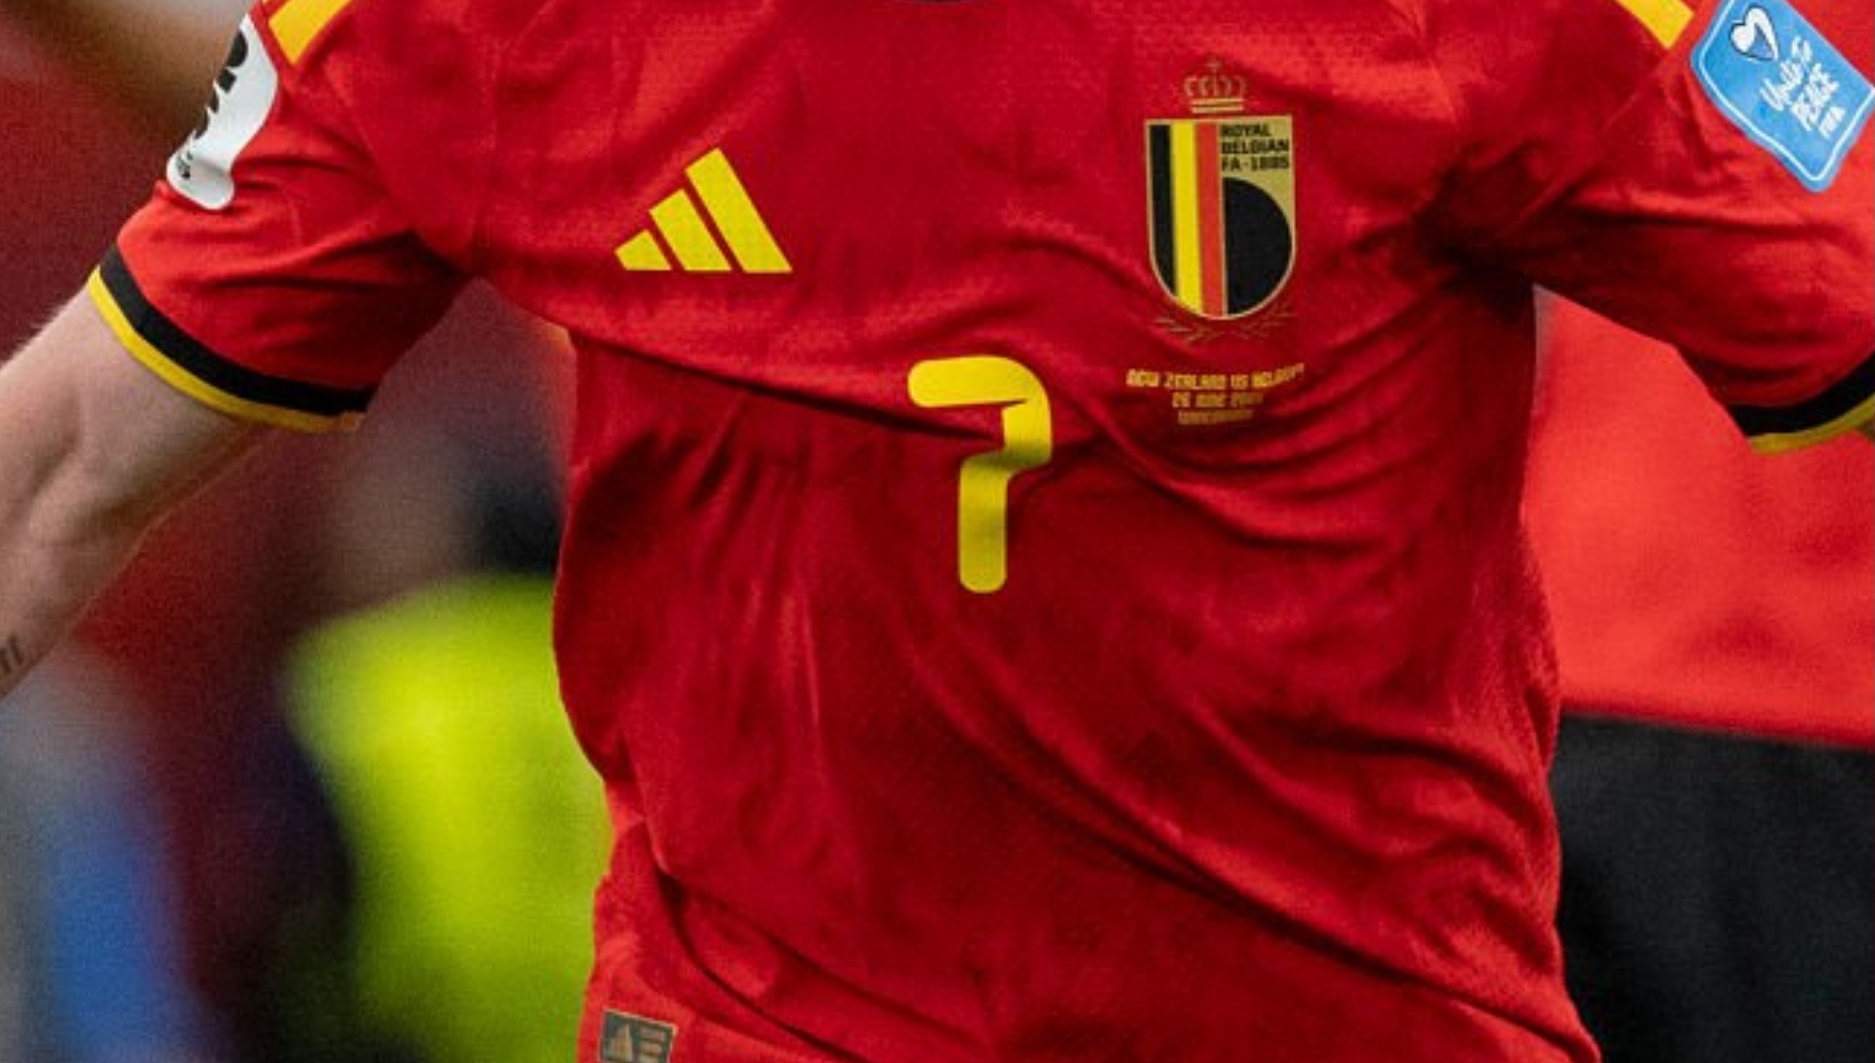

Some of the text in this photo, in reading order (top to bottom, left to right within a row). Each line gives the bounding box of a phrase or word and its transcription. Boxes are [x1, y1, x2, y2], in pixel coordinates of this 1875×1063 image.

[1221, 123, 1272, 137] ROYAL
[1221, 138, 1290, 155] BELGIAN
[907, 354, 1053, 594] 7
